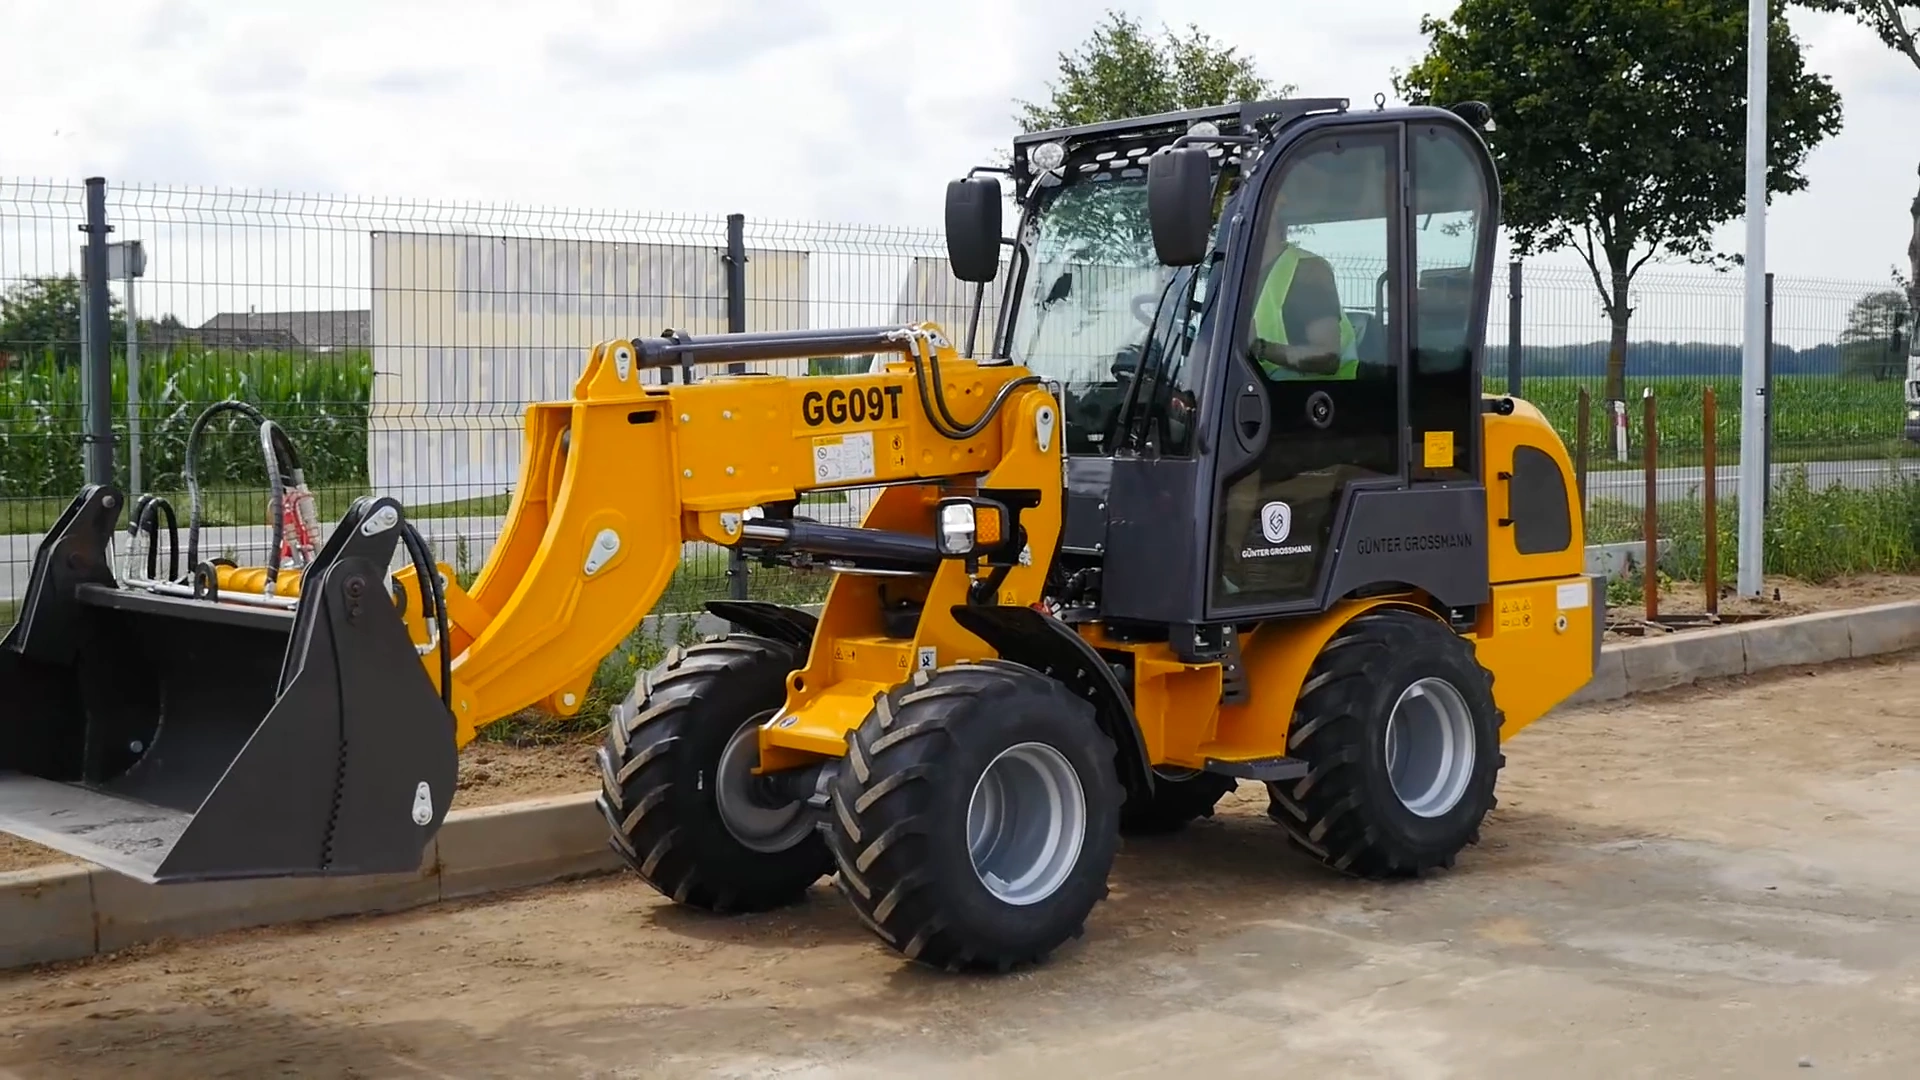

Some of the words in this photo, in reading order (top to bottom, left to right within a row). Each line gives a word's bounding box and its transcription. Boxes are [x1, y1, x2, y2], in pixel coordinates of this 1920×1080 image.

[803, 385, 903, 427] GG09T
[1241, 547, 1270, 558] GÜNTER
[1269, 545, 1312, 556] GROSSMANN
[1357, 536, 1402, 555] GÜNTER
[1404, 532, 1472, 552] GROSSMANN
